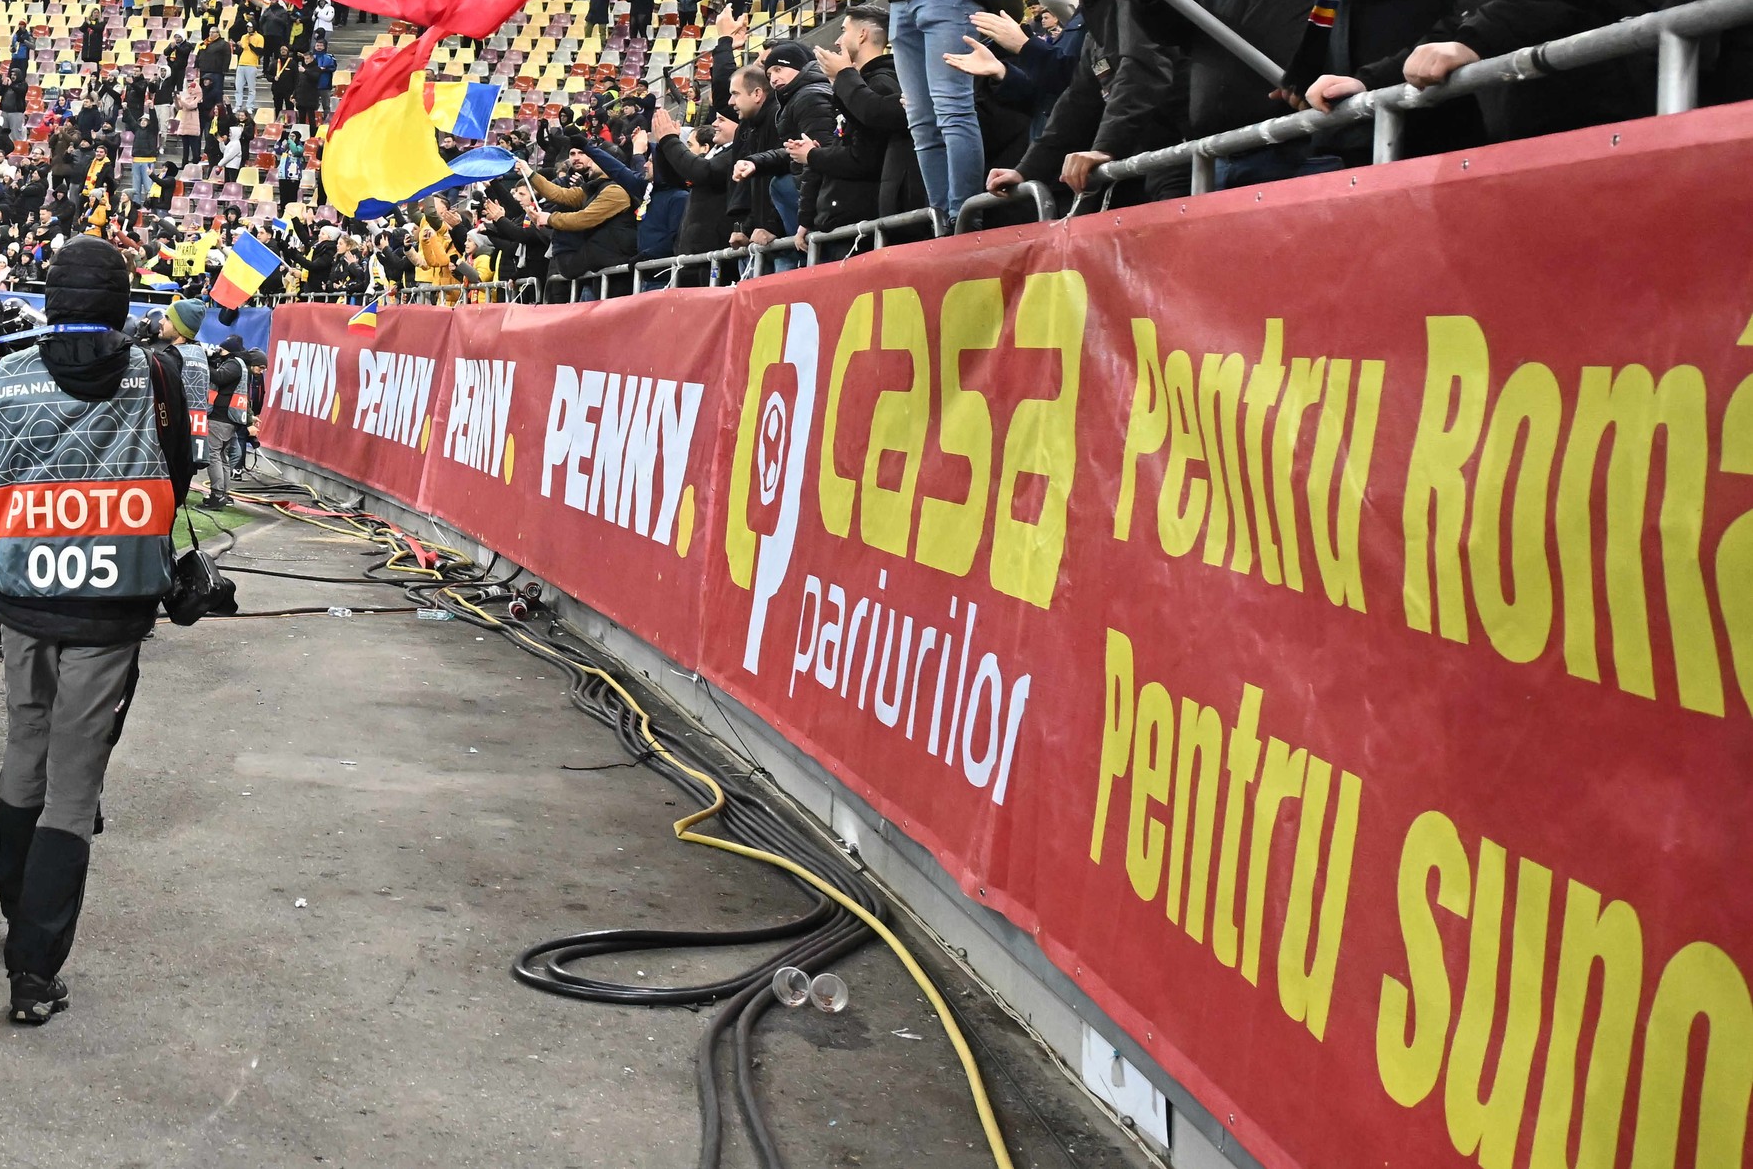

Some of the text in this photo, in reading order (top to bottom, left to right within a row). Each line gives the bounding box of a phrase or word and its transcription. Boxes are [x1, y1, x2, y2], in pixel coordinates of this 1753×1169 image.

[6, 487, 153, 530] PHOTO
[157, 401, 169, 427] EOS
[818, 269, 1088, 610] casa
[1113, 316, 1386, 614] Pentru
[27, 544, 119, 589] 005
[788, 568, 1032, 806] pariurilor
[1089, 626, 1363, 1042] Pentru
